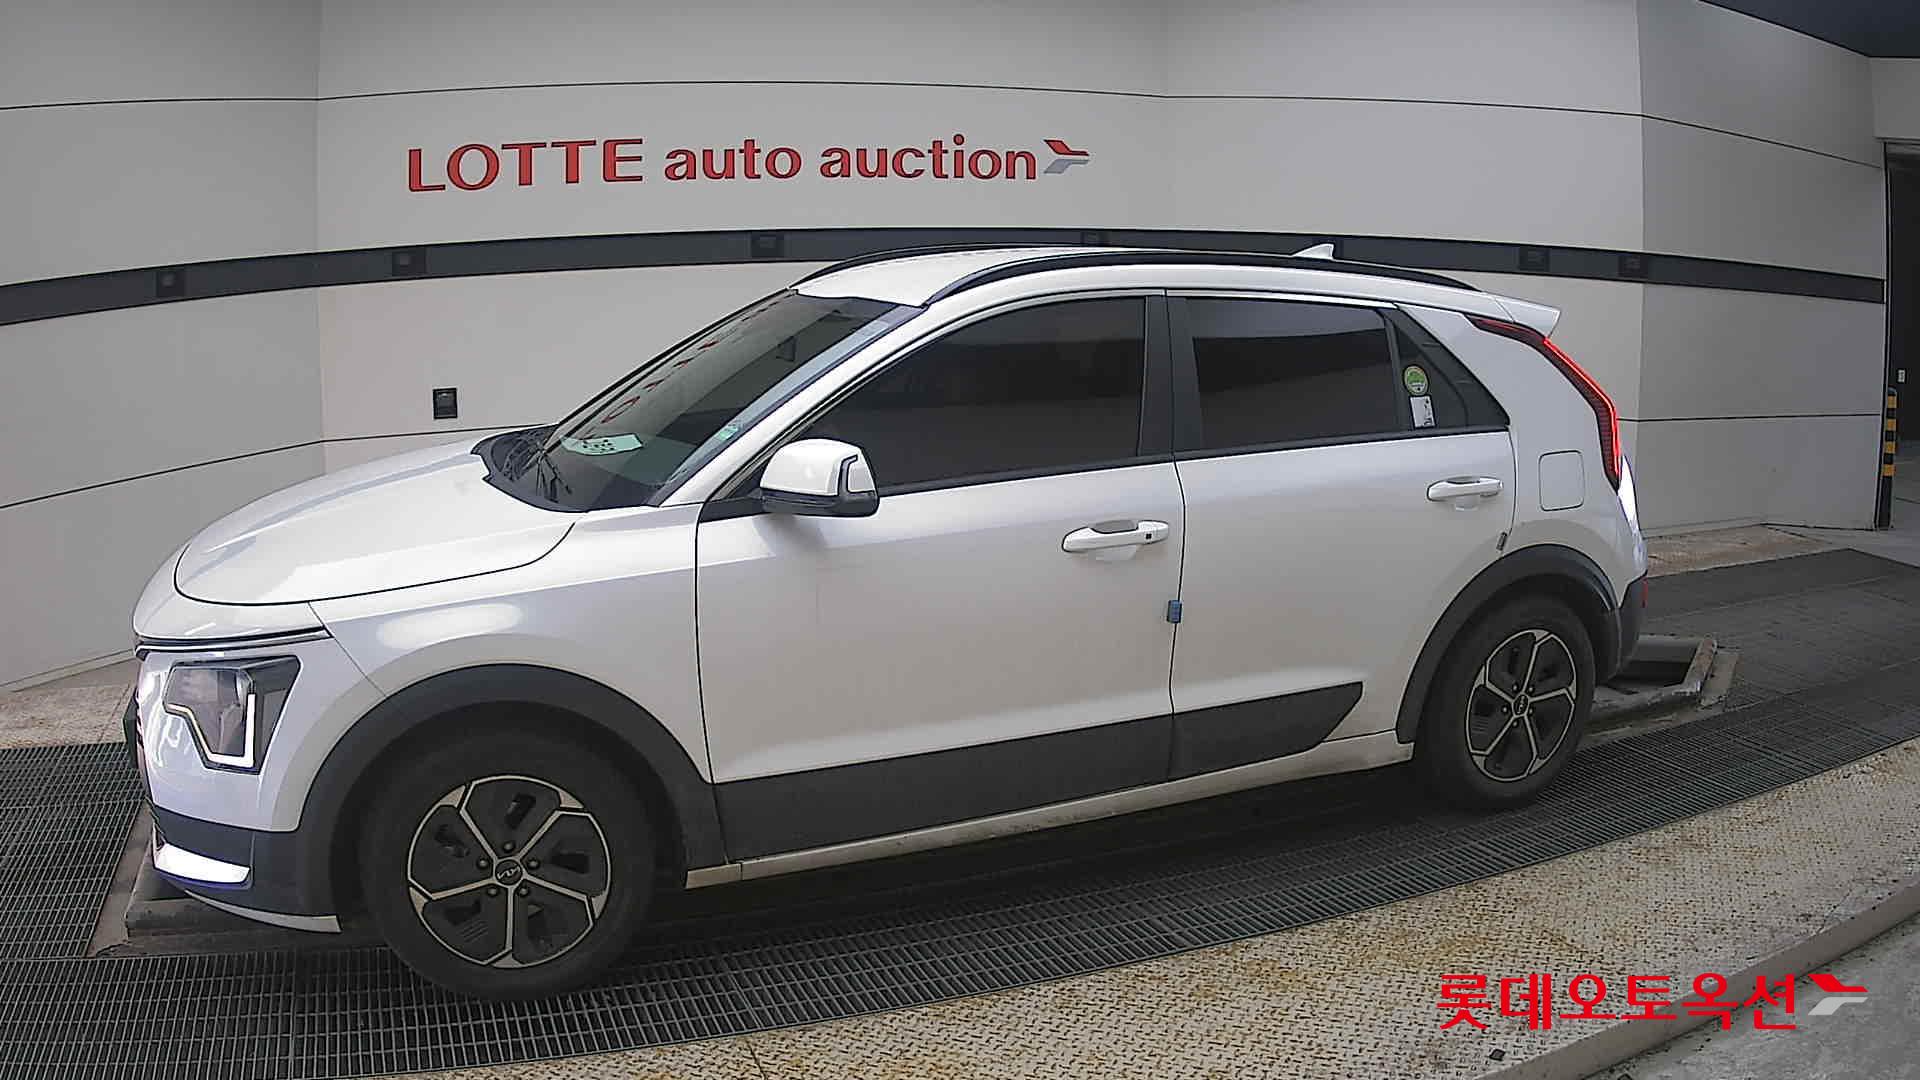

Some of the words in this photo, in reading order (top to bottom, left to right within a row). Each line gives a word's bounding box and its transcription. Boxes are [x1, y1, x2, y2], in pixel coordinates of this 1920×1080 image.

[407, 138, 644, 193] LOTTE
[663, 138, 803, 181] auto
[819, 133, 1037, 181] auction
